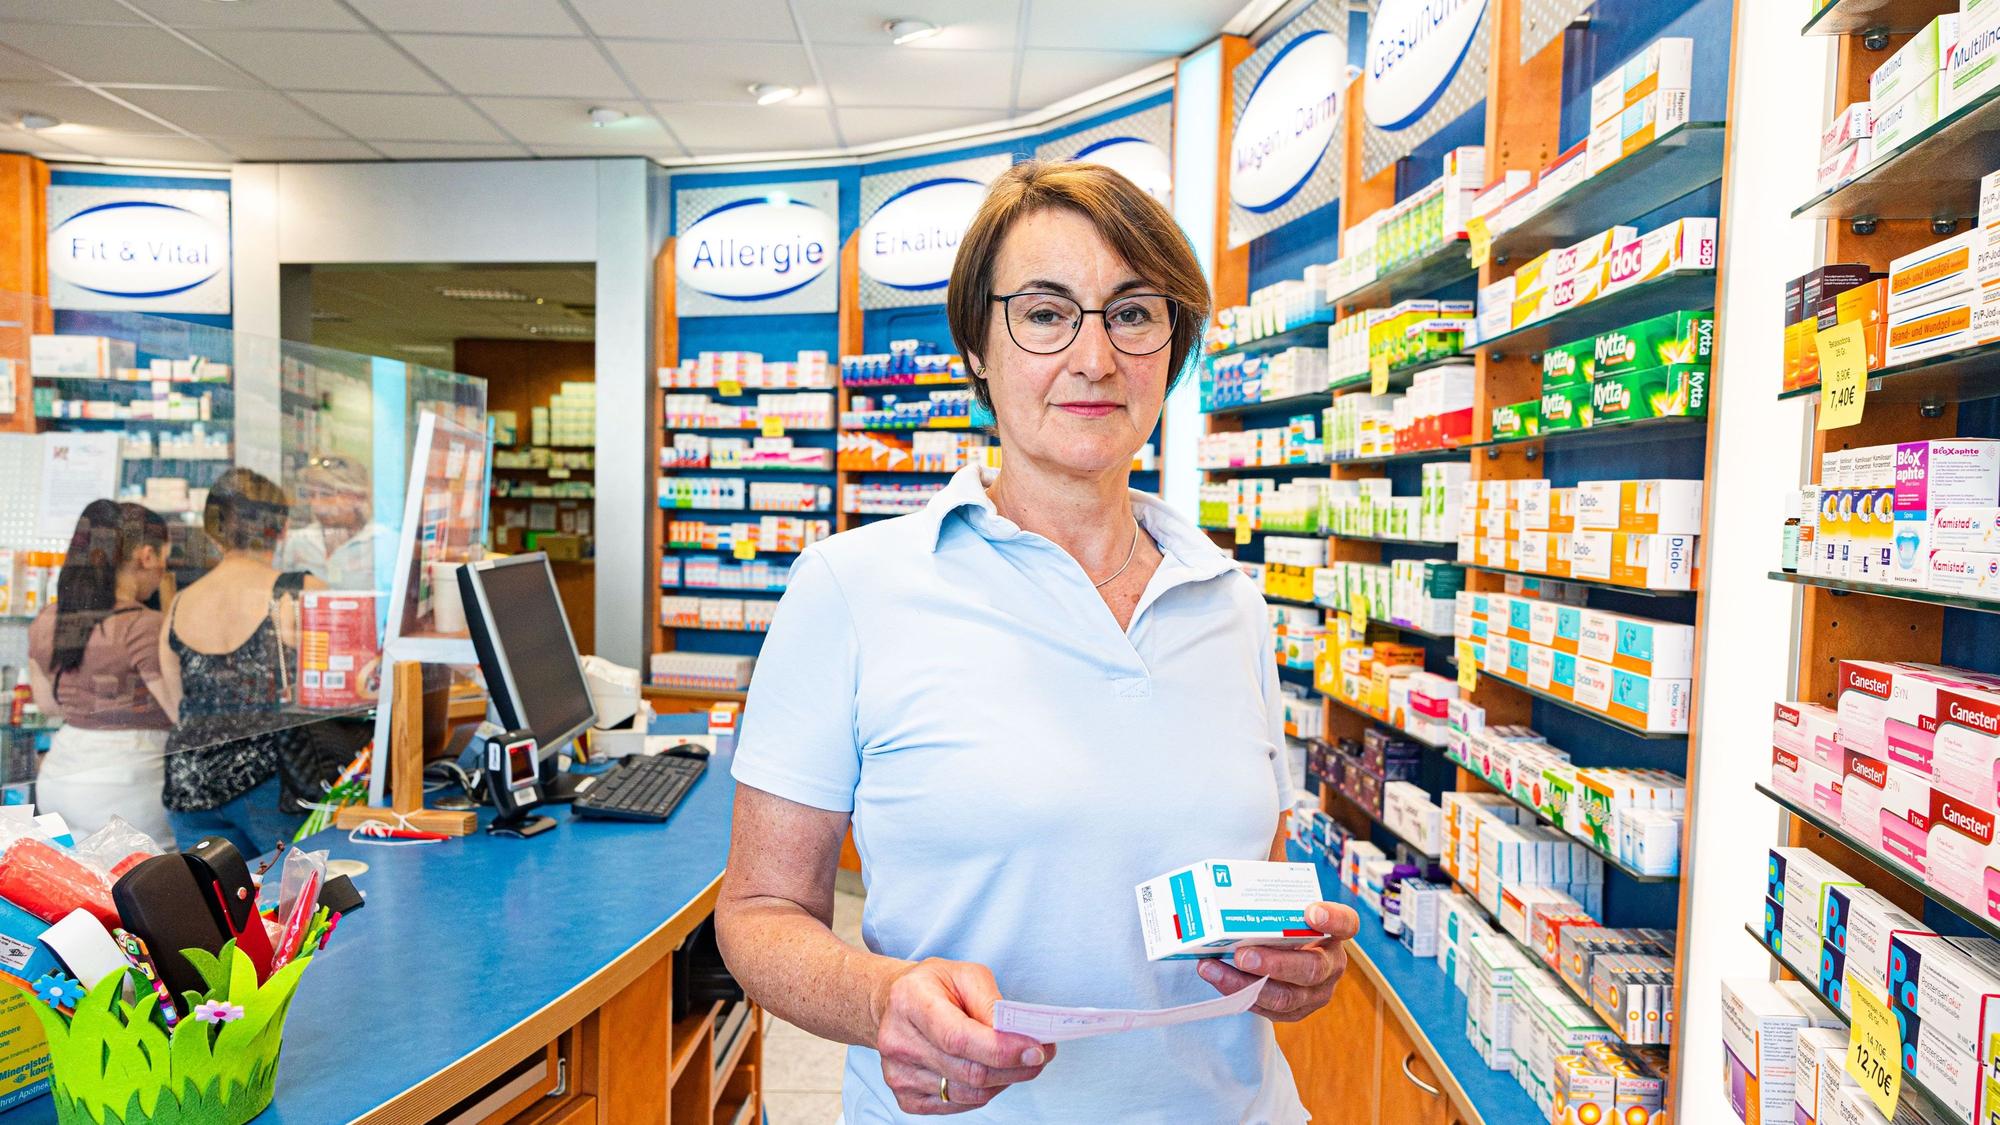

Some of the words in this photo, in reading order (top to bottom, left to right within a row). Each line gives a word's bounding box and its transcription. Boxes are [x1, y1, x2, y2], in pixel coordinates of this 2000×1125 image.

[1875, 54, 1902, 86] Multilind
[1238, 130, 1280, 172] Magen
[1295, 91, 1337, 138] Darm
[1876, 104, 1904, 136] Multilind
[72, 237, 107, 260] Fit
[119, 240, 136, 261] &
[147, 240, 210, 265] Vital
[692, 236, 824, 275] Allergie
[1702, 239, 1713, 265] doc
[1611, 247, 1642, 282] doc
[1554, 280, 1575, 306] doc
[1697, 319, 1713, 356] Kytta
[1892, 328, 1910, 342] Brand-
[1911, 323, 1923, 337] und
[1924, 315, 1951, 334] Wundgel
[1595, 332, 1627, 364] Kytta
[1544, 350, 1569, 376] Kytta
[1593, 380, 1623, 412] Kytta
[1689, 371, 1705, 408] Kytta
[1831, 385, 1856, 411] 7,40€
[1541, 393, 1566, 418] Kytta
[1896, 466, 1925, 484] aphte
[1903, 511, 1914, 520] Spray
[1937, 517, 1970, 530] Kamistad
[1671, 537, 1683, 574] Diclo-
[1933, 560, 1966, 574] Kamistad
[1672, 683, 1680, 706] Diclox
[1850, 671, 1887, 695] Canesten
[1670, 708, 1678, 727] forte
[1778, 707, 1798, 723] Canesten
[1950, 701, 1998, 732] Canesten
[1776, 752, 1797, 769] Canesten
[1852, 757, 1884, 784] Canesten
[1914, 816, 1924, 829] TAG
[1942, 803, 1988, 838] Canesten
[1246, 914, 1255, 922] mg
[0, 1025, 21, 1037] dbeere
[1572, 1033, 1609, 1041] ZENTIVA
[1857, 1045, 1893, 1096] 12,70€
[0, 1096, 17, 1107] hrer
[20, 1083, 49, 1100] Apothek
[1620, 1081, 1659, 1089] NUROFEN
